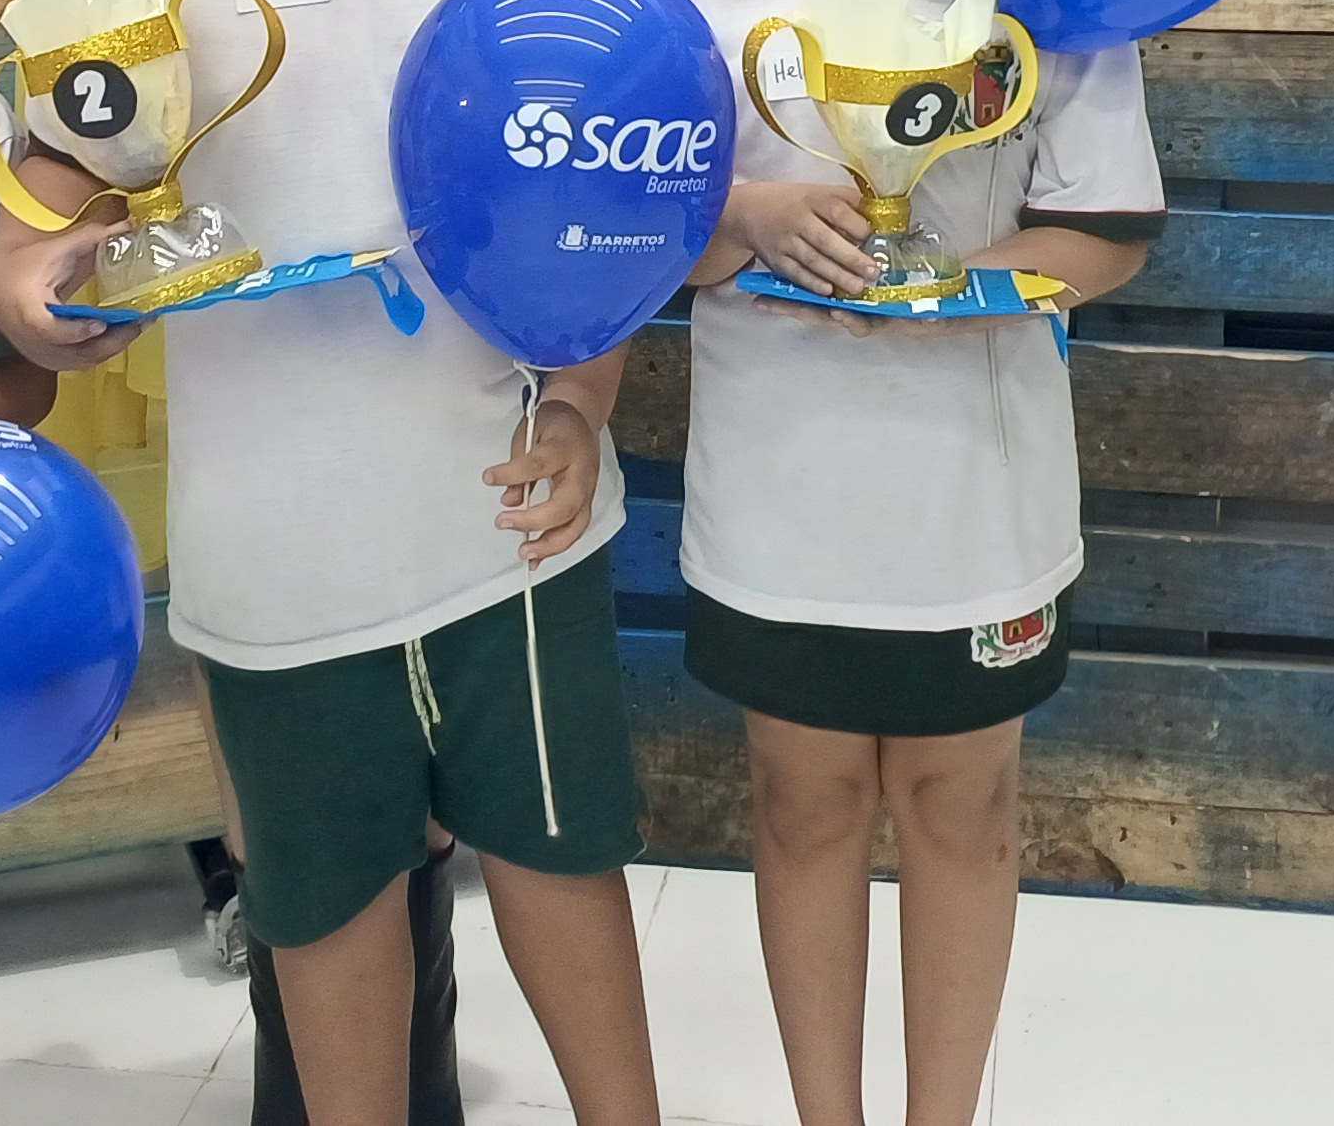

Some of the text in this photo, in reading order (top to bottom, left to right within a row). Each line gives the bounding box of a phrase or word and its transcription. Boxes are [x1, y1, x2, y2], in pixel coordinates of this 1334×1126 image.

[73, 70, 113, 123] 2
[904, 93, 942, 137] 3
[571, 115, 717, 174] saae
[646, 175, 707, 193] Barretos
[591, 234, 666, 246] BARRETOS
